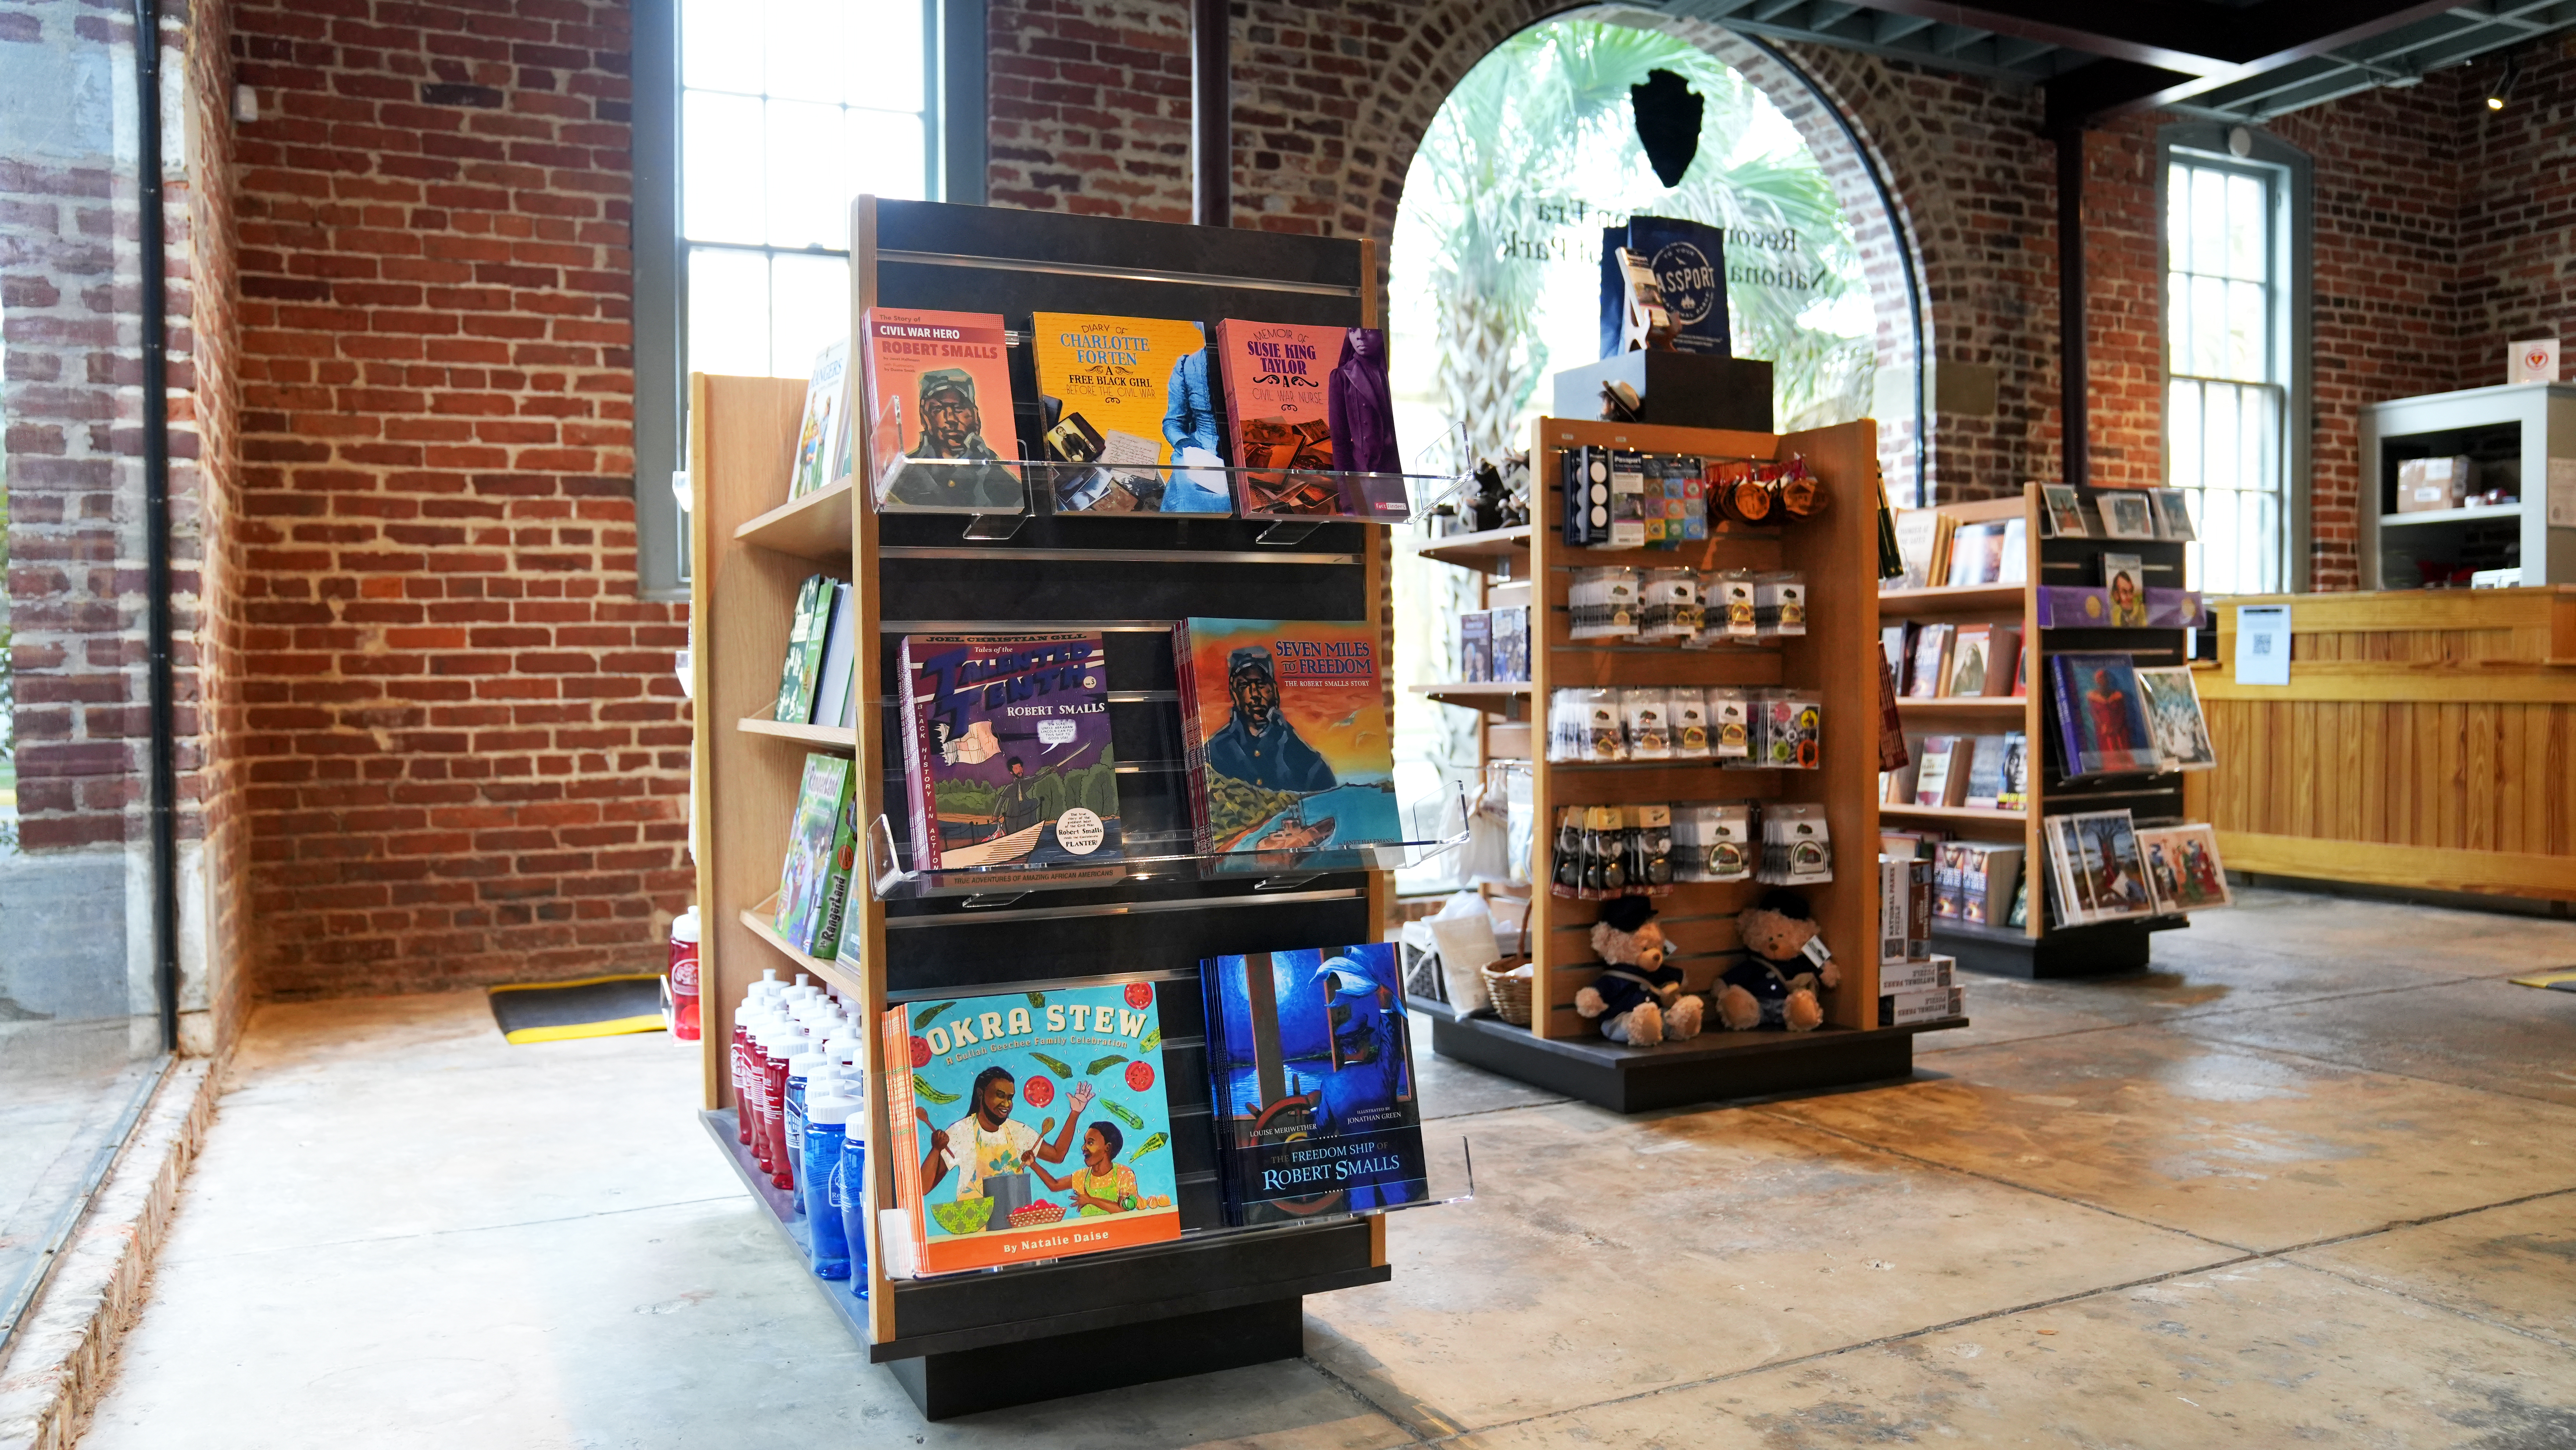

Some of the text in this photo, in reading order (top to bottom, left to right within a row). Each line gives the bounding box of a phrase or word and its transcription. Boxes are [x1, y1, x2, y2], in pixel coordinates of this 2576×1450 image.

[1655, 266, 1715, 294] ASSPORT
[880, 325, 960, 339] CIVIL WAR HERO
[1081, 324, 1128, 335] DIARY OF
[1253, 329, 1309, 343] MEMOIR OF
[882, 340, 998, 359] ROBERT SMALLS
[1060, 333, 1150, 351] CHARLOTTE
[1247, 340, 1317, 360] SUSIE KING
[1076, 349, 1137, 366] FORTEN
[1260, 357, 1307, 375] TAYLOR
[1105, 365, 1114, 375] A
[1068, 374, 1153, 388] FREE BLACK GIRL
[1283, 375, 1290, 388] A
[1066, 384, 1156, 399] BEFORE THE CIVIL WAR
[1252, 388, 1324, 405] CIVIL WAR NURSE
[966, 635, 1049, 643] CHRISTIAN
[1275, 640, 1370, 657] SEVEN MILES
[919, 642, 1093, 701] TALENTED
[1282, 658, 1372, 674] TO FREEDOM
[933, 662, 1086, 744] TENTH
[1006, 703, 1105, 717] ROBERT SMALLS
[917, 704, 939, 870] BLACK HISTORY IN ACTION
[971, 875, 1012, 883] ADVENTURES
[1022, 873, 1050, 881] AMAZING
[1051, 871, 1077, 880] AFRICAN
[1077, 869, 1113, 879] AMERICANS
[821, 875, 845, 942] RangerLand
[926, 1004, 1148, 1056] OKRA STEW
[945, 1035, 1128, 1066] A Gullah Geechee Family Celebration
[1347, 1111, 1401, 1125] JONATHAN GREEN
[1249, 1123, 1317, 1137] LOUISE MERIWETHER
[1271, 1142, 1388, 1164] THE FREEDOM SHIP OF
[1262, 1156, 1400, 1190] ROBERT SMALLS
[1003, 1230, 1109, 1253] By Natalie Daise
